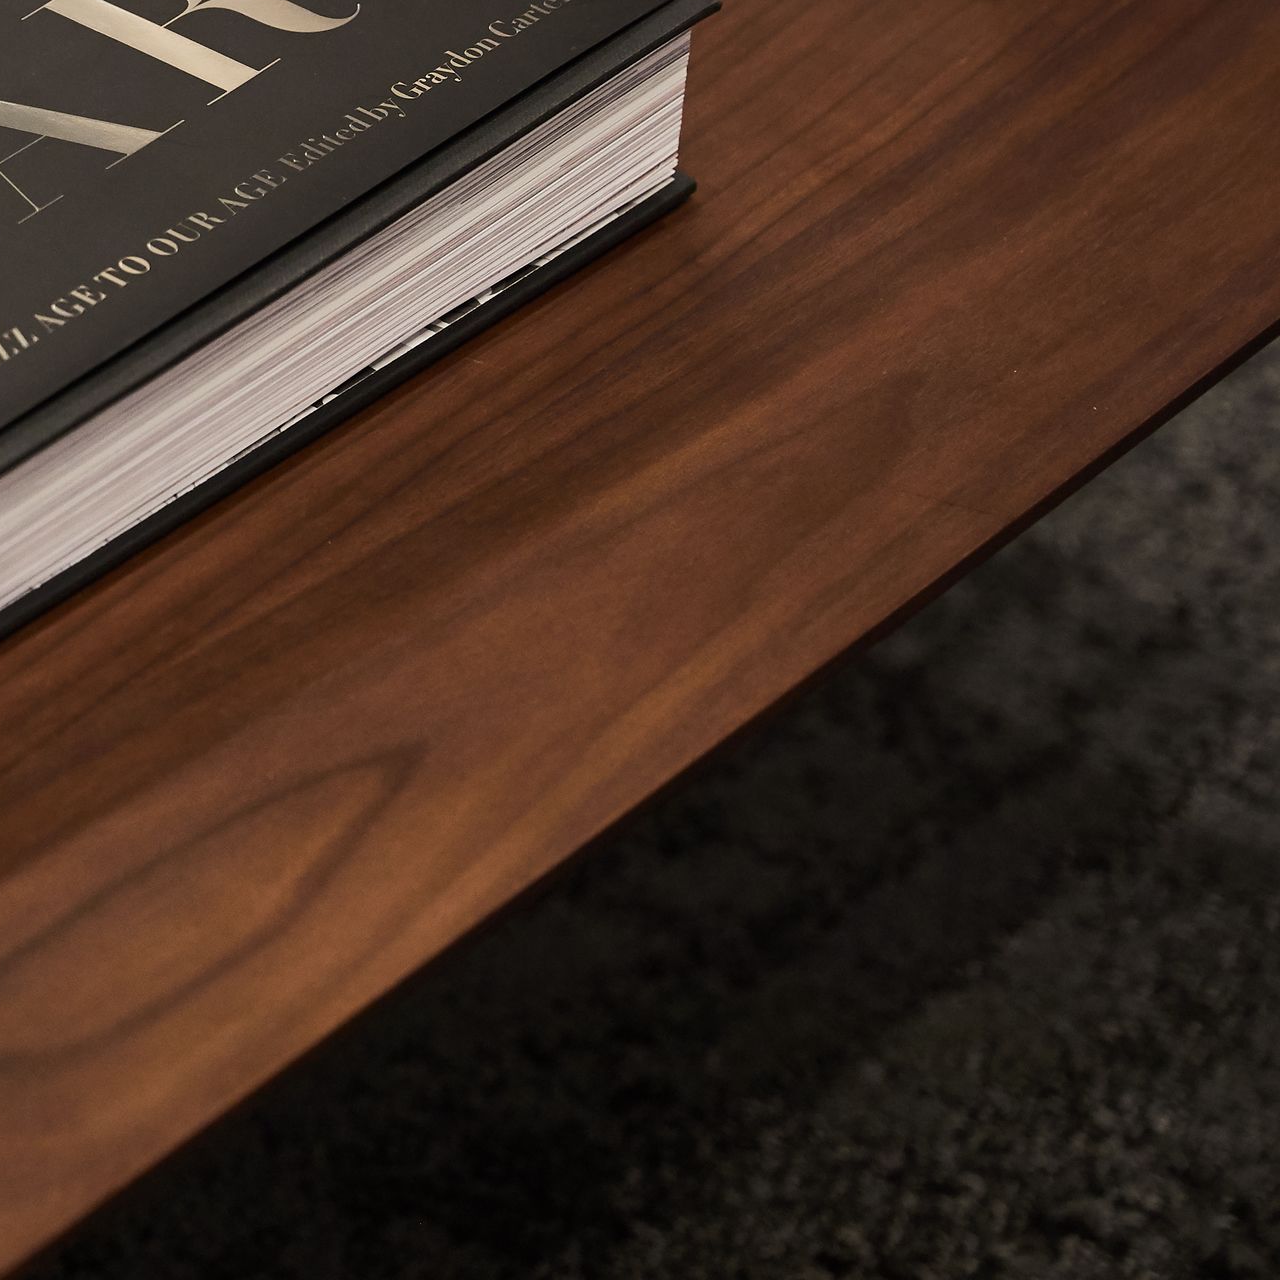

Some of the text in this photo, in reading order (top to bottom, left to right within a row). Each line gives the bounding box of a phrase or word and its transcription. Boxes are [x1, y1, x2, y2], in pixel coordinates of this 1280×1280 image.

[34, 284, 107, 334] AGE
[94, 255, 151, 289] TO
[146, 210, 227, 257] OUR
[217, 168, 287, 216] AGE
[277, 107, 373, 173] Edited
[364, 96, 406, 124] by
[390, 33, 500, 101] Graydon
